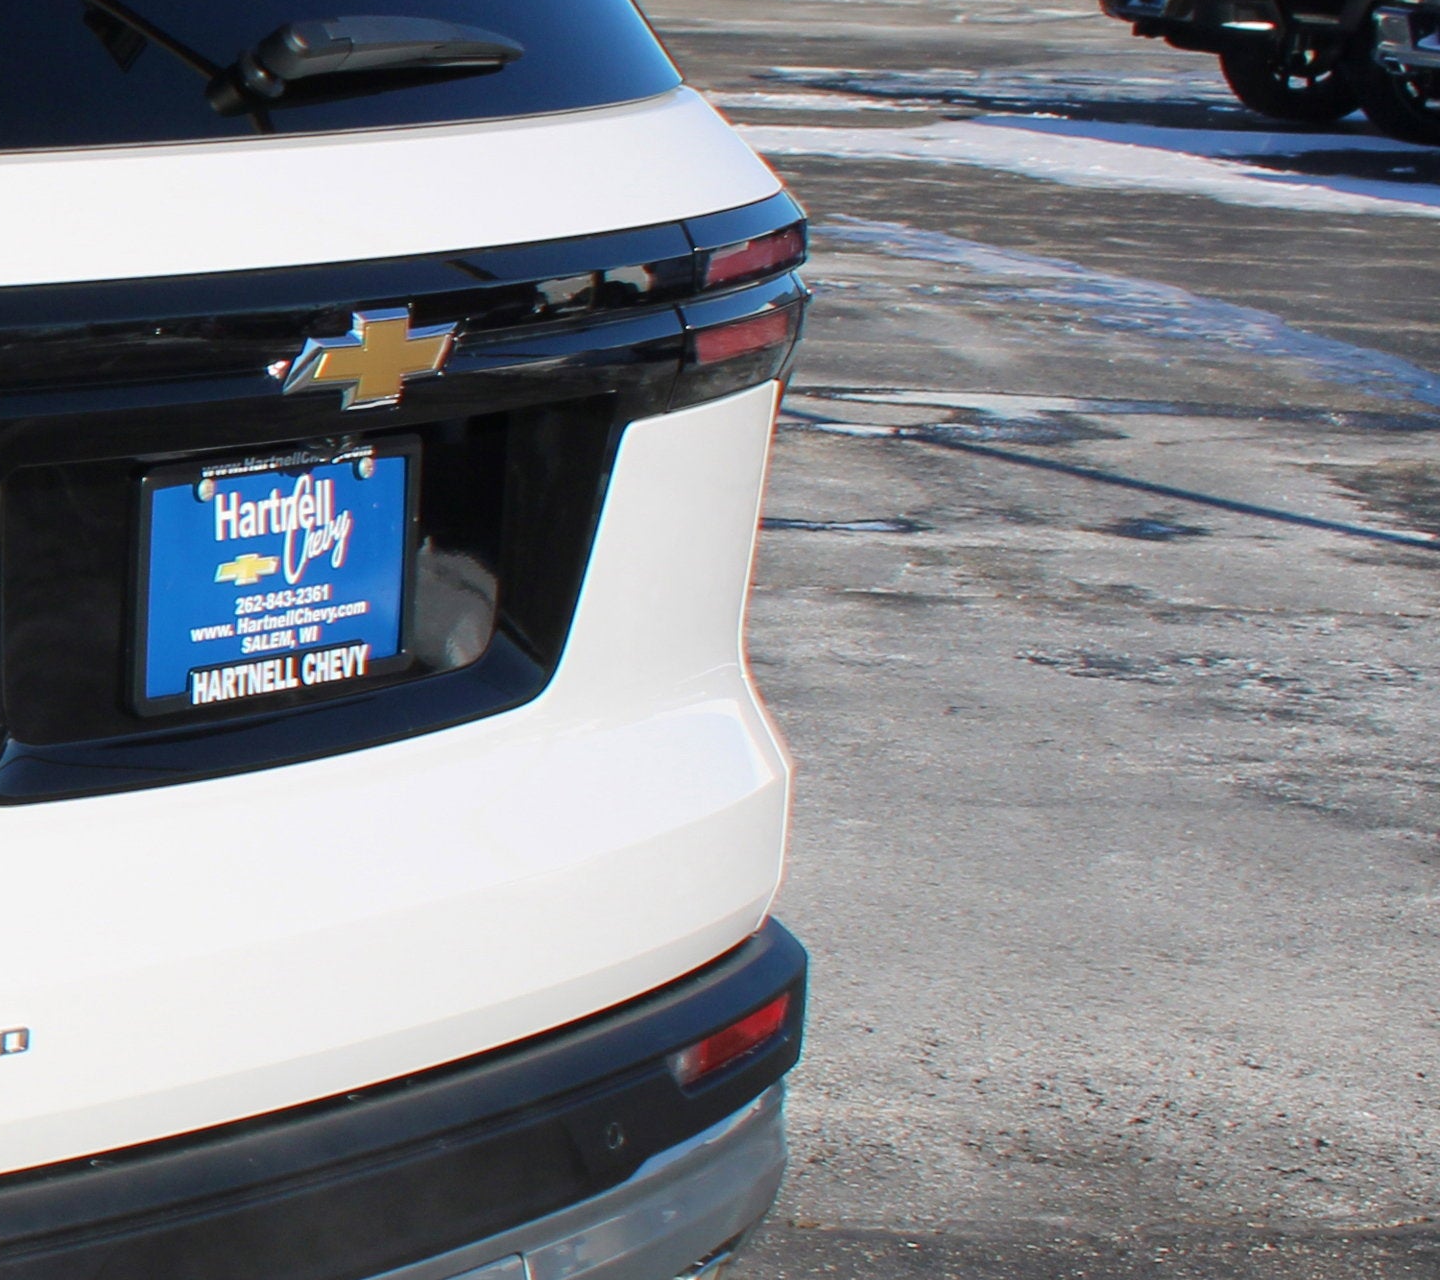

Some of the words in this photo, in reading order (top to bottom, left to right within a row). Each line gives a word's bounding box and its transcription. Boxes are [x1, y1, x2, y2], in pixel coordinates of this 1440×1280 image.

[215, 479, 334, 541] Hartnell
[283, 473, 353, 584] Chevy
[235, 584, 330, 615] 262-843-2361
[241, 629, 298, 654] SALEM,
[299, 625, 321, 644] WI
[192, 656, 299, 705] HARTNELL
[302, 644, 370, 686] CHEVY
